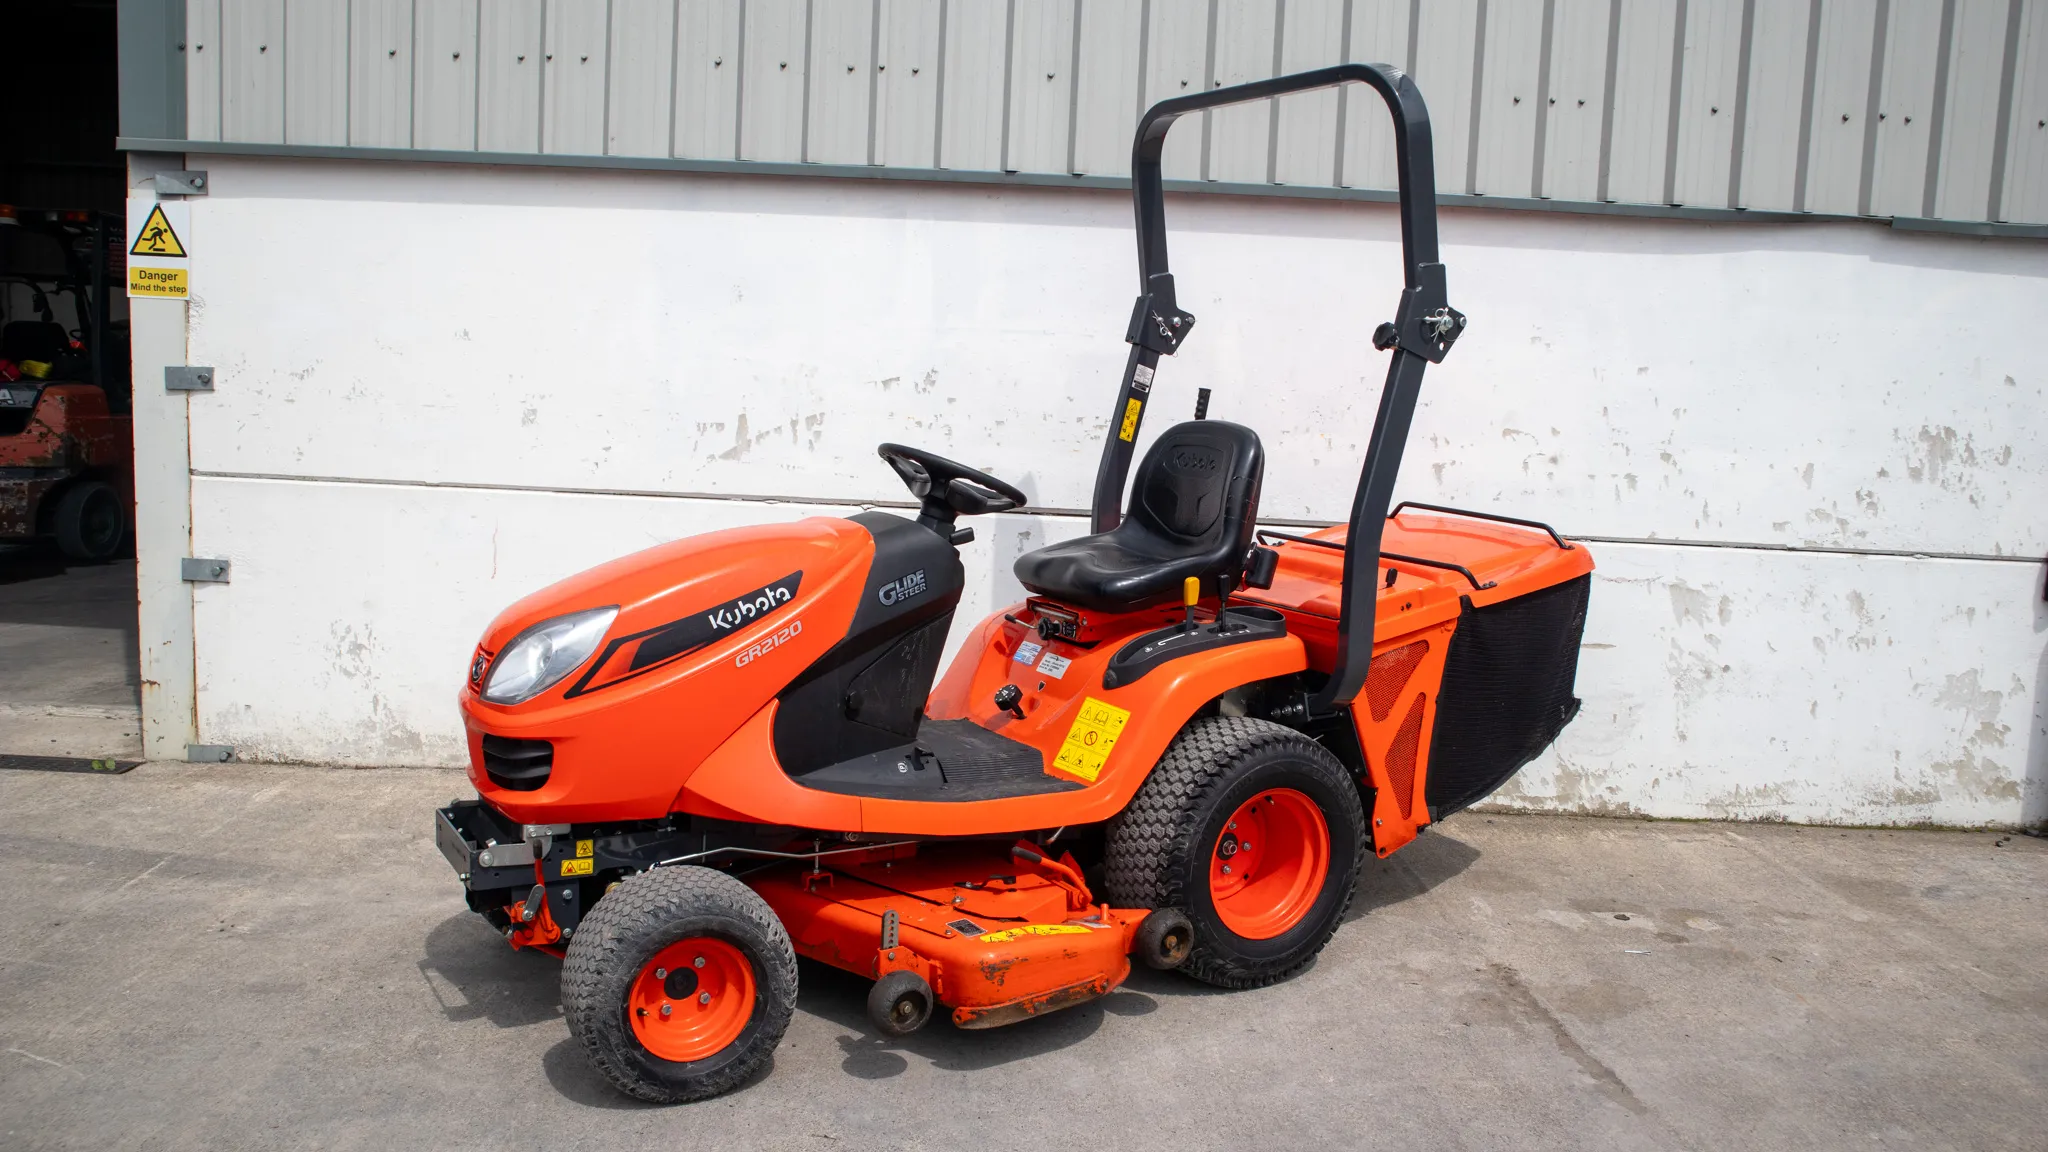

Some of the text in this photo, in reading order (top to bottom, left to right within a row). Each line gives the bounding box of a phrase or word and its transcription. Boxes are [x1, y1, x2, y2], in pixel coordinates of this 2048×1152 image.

[139, 270, 178, 283] Danger
[130, 283, 187, 294] Mind the step
[1173, 451, 1216, 470] Kubota
[878, 570, 925, 606] GLIDE
[897, 582, 927, 601] STEER
[708, 587, 791, 630] Kubota
[735, 619, 803, 668] GR2120
